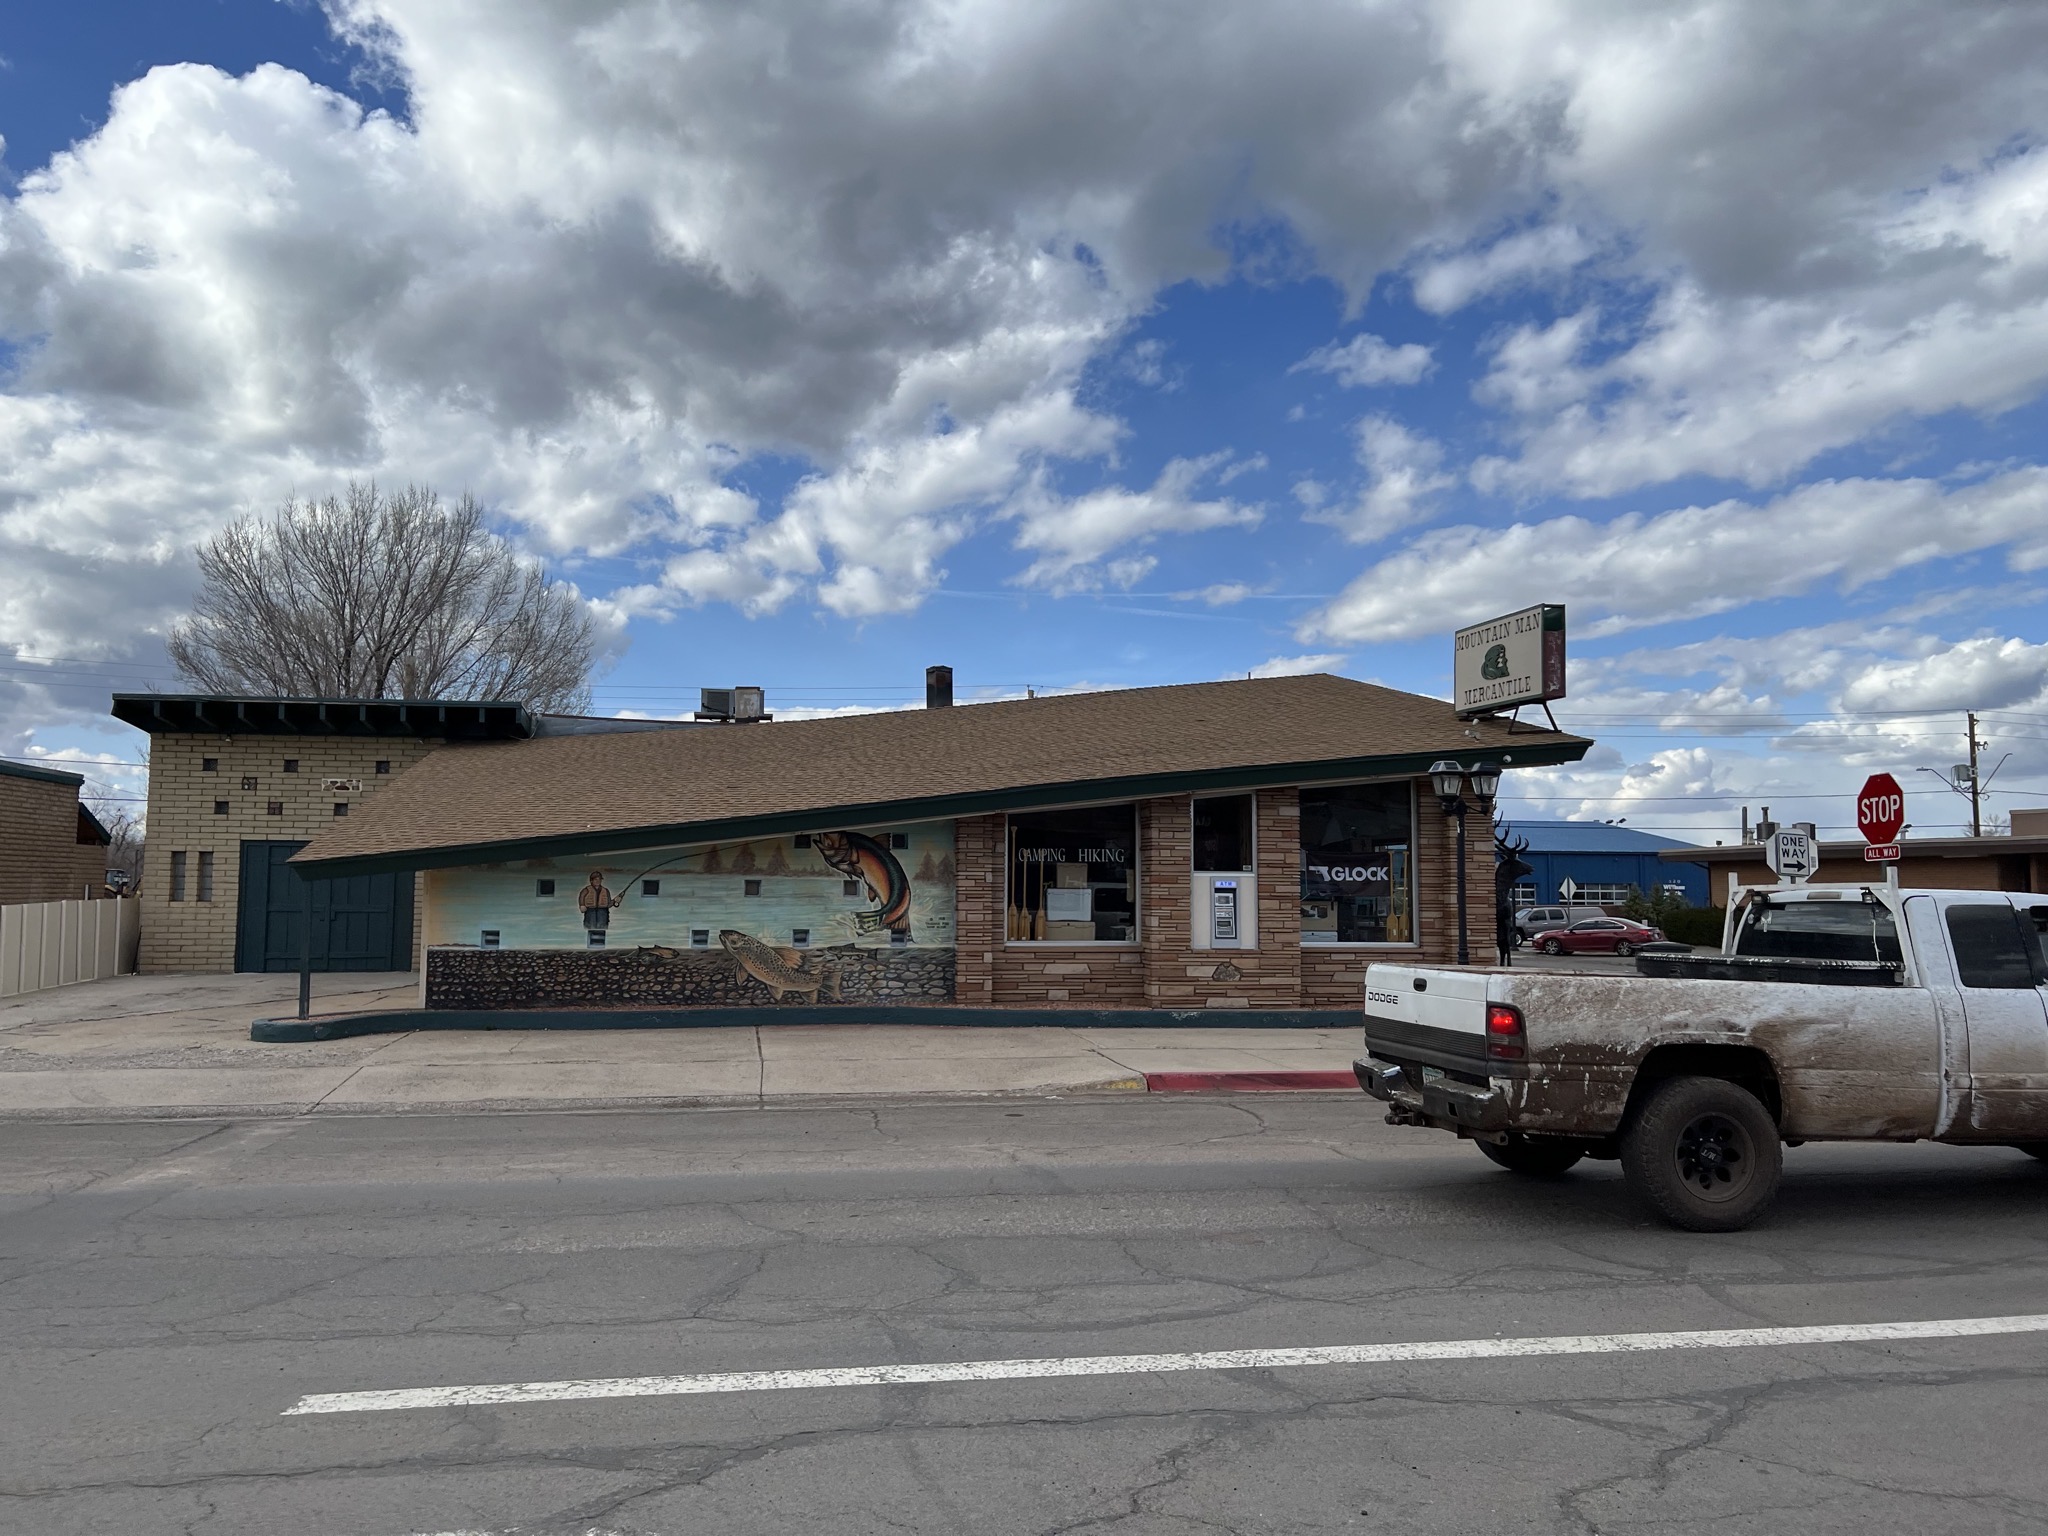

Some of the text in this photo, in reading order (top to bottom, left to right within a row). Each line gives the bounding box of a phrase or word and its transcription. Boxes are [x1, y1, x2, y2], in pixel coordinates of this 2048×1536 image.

[1456, 612, 1541, 651] MOUNTAIN MAN
[1464, 676, 1531, 705] MERCANTILE
[1861, 794, 1900, 824] STOP
[1781, 836, 1805, 848] ONE
[1018, 848, 1125, 862] CAMPING HIKING
[1781, 848, 1806, 859] WAY
[1868, 848, 1897, 858] ALL WAY
[1331, 866, 1389, 881] GLOCK
[1368, 991, 1399, 1005] DODGE
